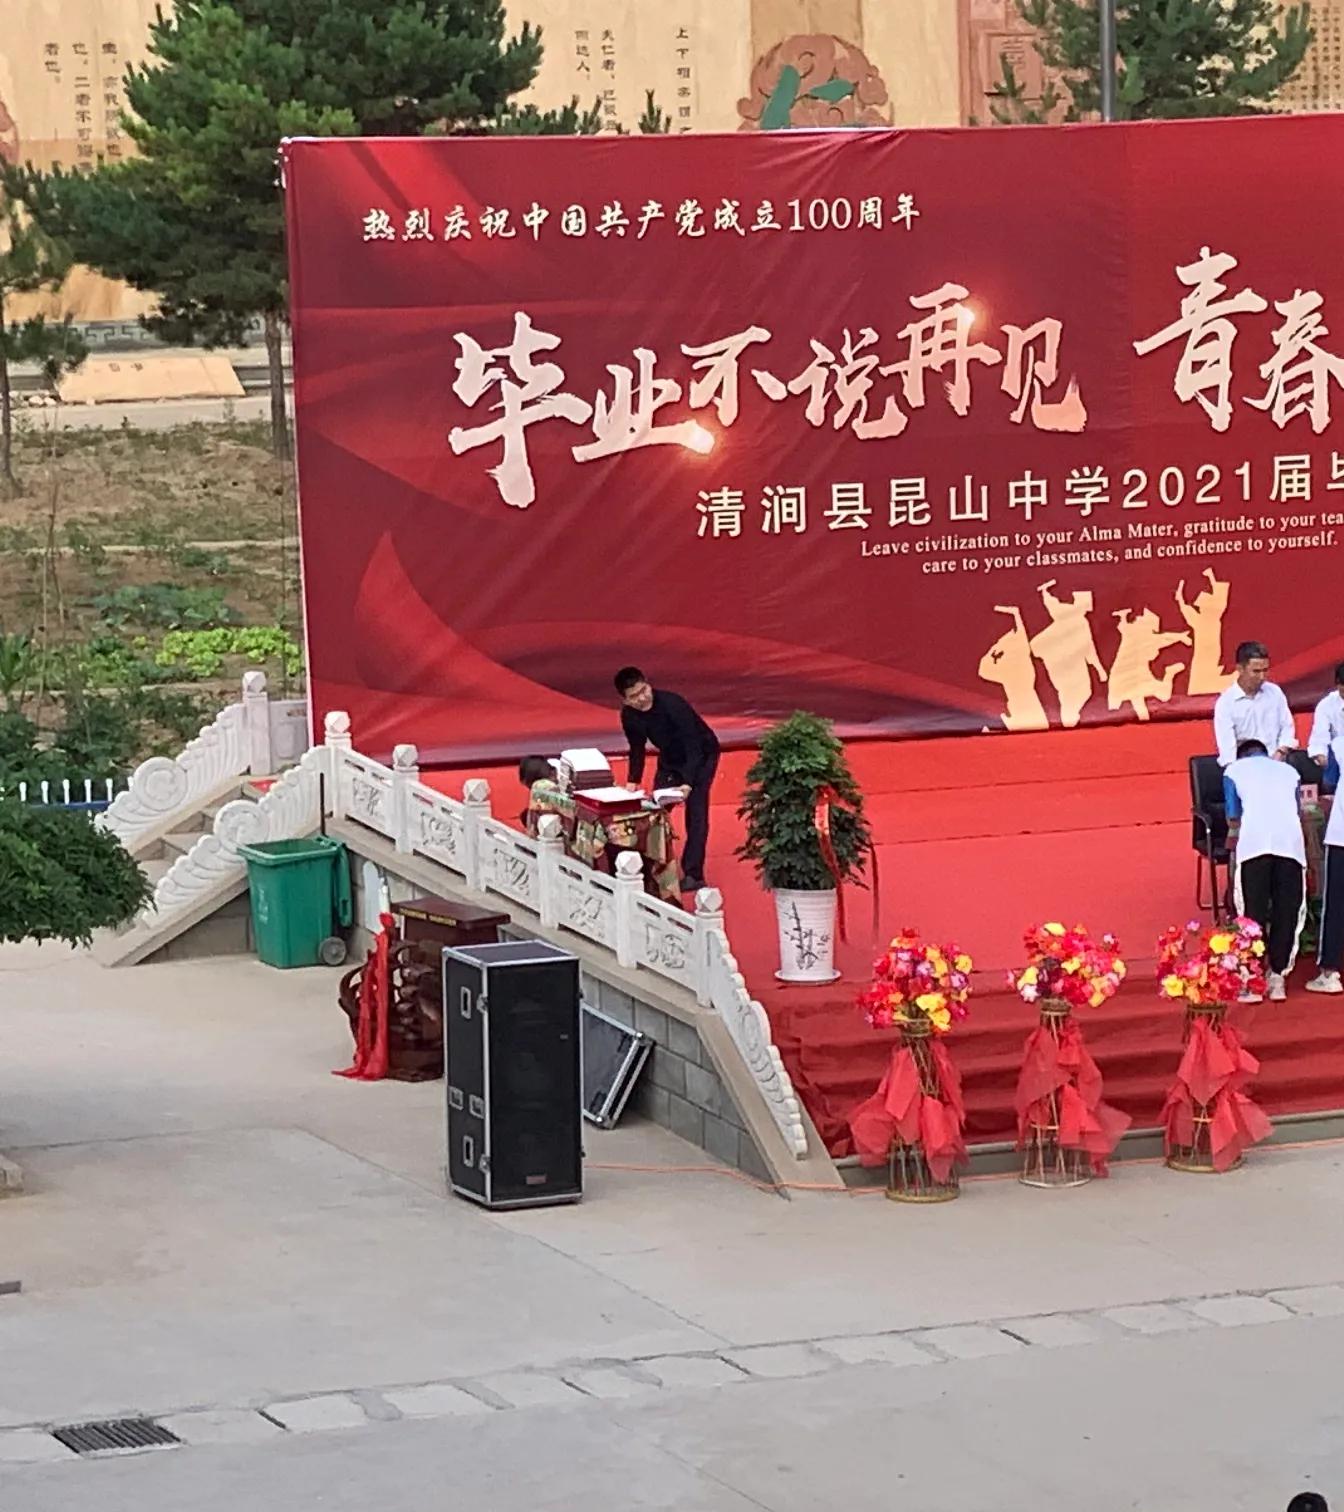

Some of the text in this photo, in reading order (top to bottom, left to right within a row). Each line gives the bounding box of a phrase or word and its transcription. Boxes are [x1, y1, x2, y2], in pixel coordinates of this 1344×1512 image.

[361, 193, 922, 243] 热烈庆祝中国共产党成立100周年
[448, 282, 1089, 509] 毕业不说再见
[861, 541, 911, 557] Leave
[915, 533, 1010, 553] civilization
[1014, 532, 1032, 547] to
[1035, 530, 1074, 549] your
[1078, 525, 1122, 543] Alma
[1128, 522, 1180, 539] Mater,
[1183, 516, 1255, 539] gratitude
[1259, 513, 1276, 530] to
[1279, 512, 1317, 529] your
[922, 529, 1339, 574] care to your classmates, and confidence to yourself.
